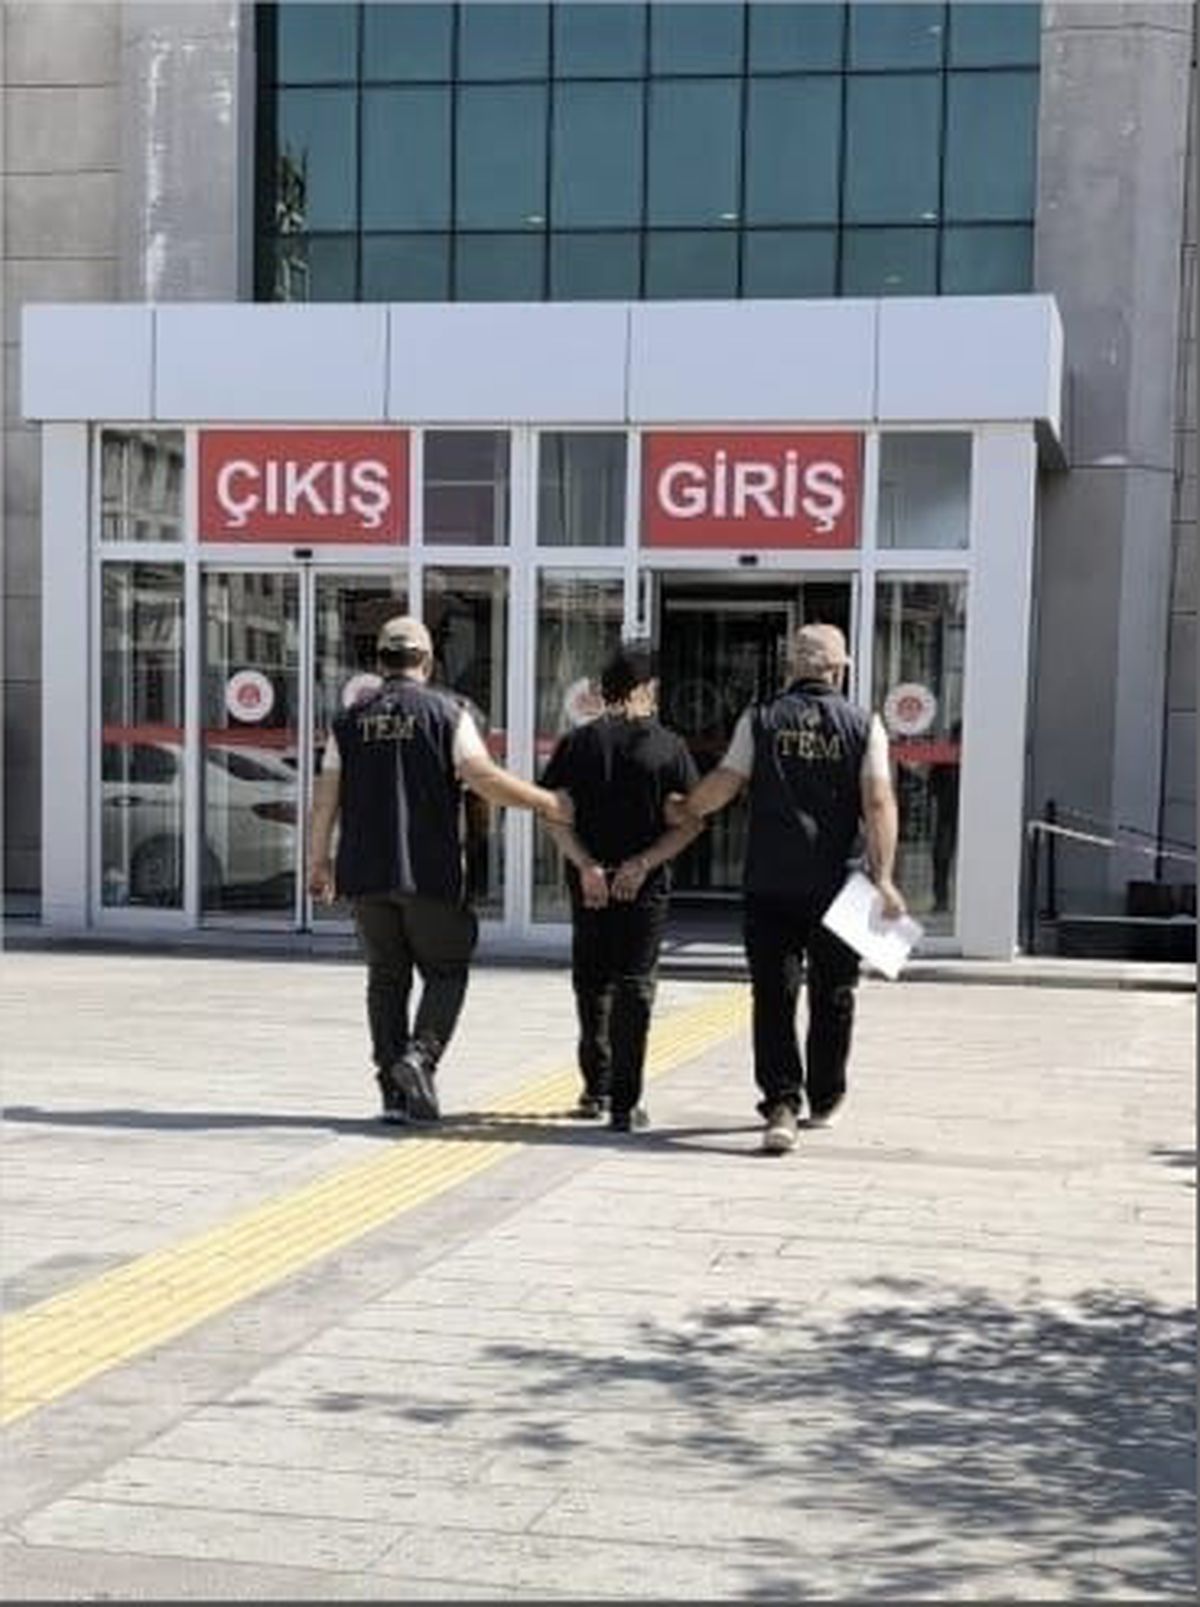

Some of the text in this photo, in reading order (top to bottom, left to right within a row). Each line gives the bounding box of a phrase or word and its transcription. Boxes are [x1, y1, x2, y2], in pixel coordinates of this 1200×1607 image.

[216, 459, 391, 530] ÇIKIŞ
[657, 449, 846, 533] GİRİŞ
[359, 713, 416, 742] TEM
[778, 730, 843, 761] TEM
